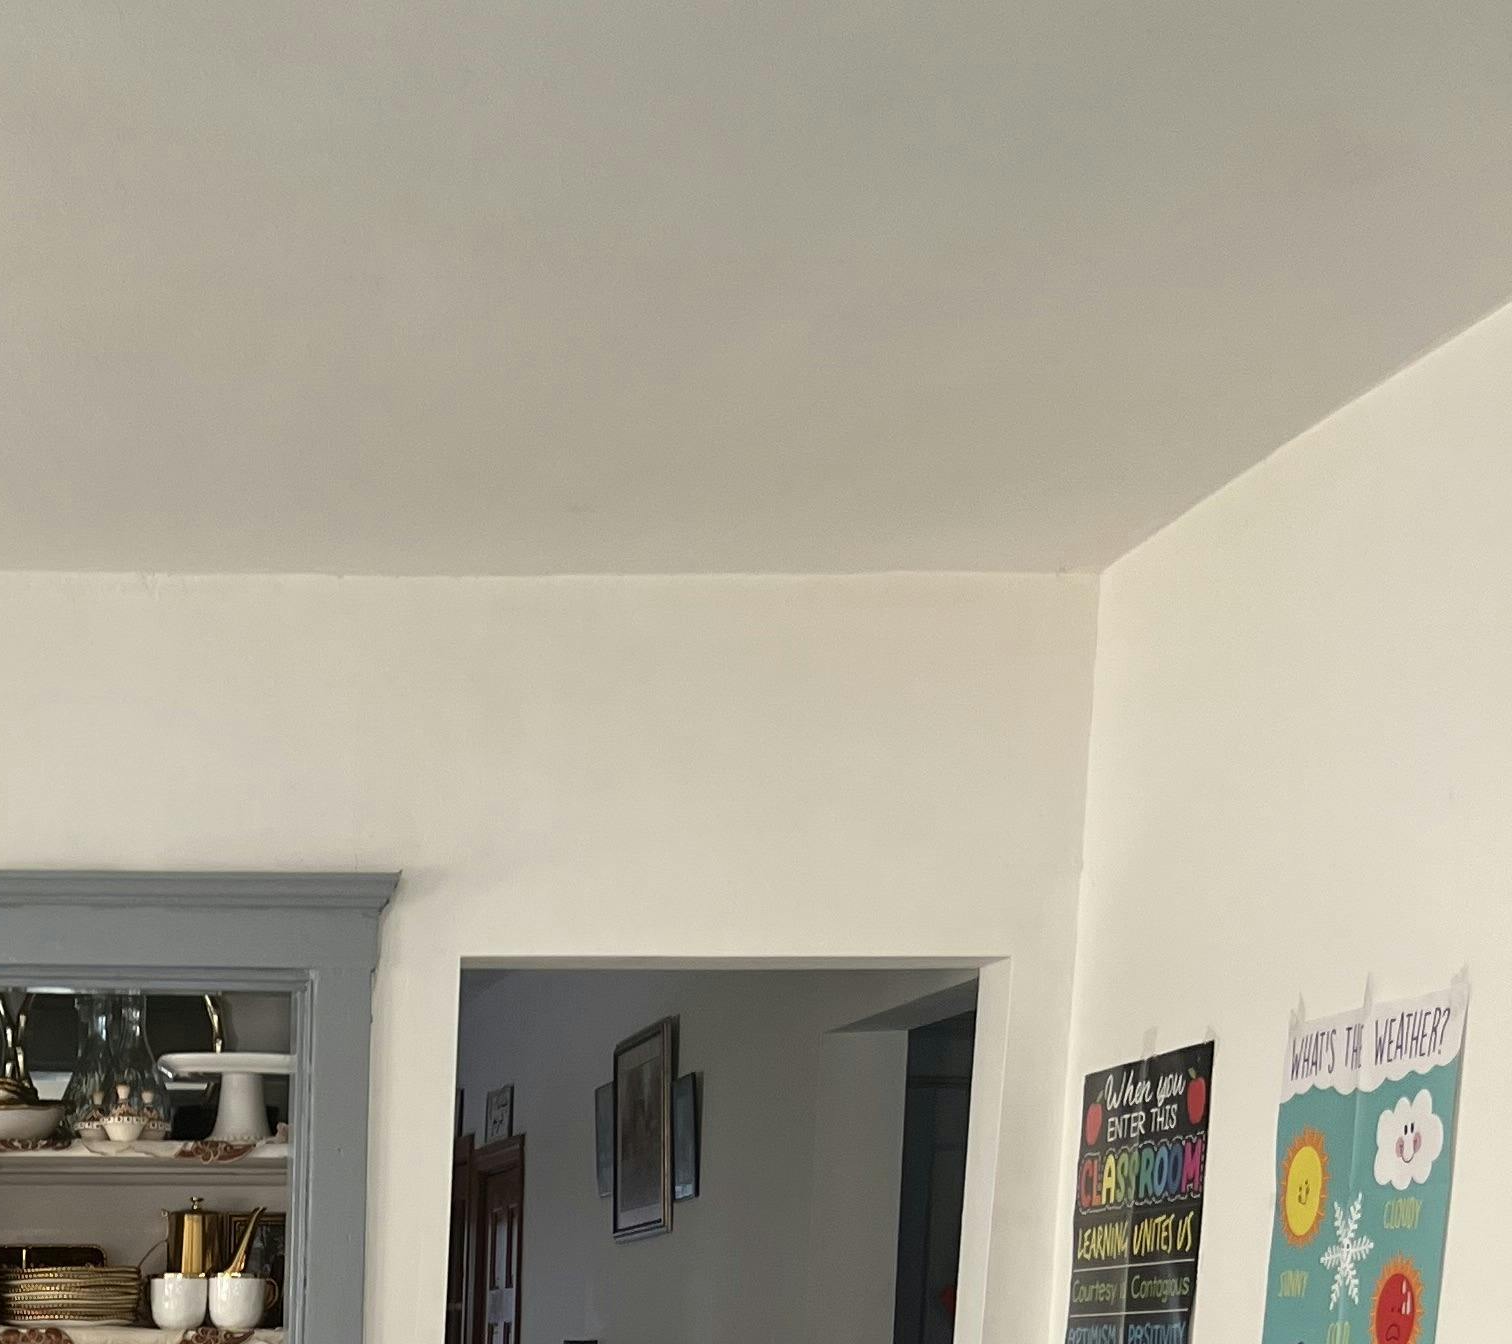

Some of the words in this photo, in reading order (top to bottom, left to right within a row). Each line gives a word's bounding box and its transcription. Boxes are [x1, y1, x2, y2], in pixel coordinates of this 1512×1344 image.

[1291, 1029, 1336, 1081] WHAT'S
[1375, 1007, 1450, 1065] WEATHER?
[1105, 1070, 1152, 1110] When
[1156, 1073, 1186, 1105] you
[1107, 1111, 1145, 1142] ENTER
[1150, 1104, 1178, 1132] THIS
[1080, 1138, 1204, 1208] CLASSROOM
[1133, 1213, 1175, 1256] UNITES
[1177, 1211, 1194, 1252] US
